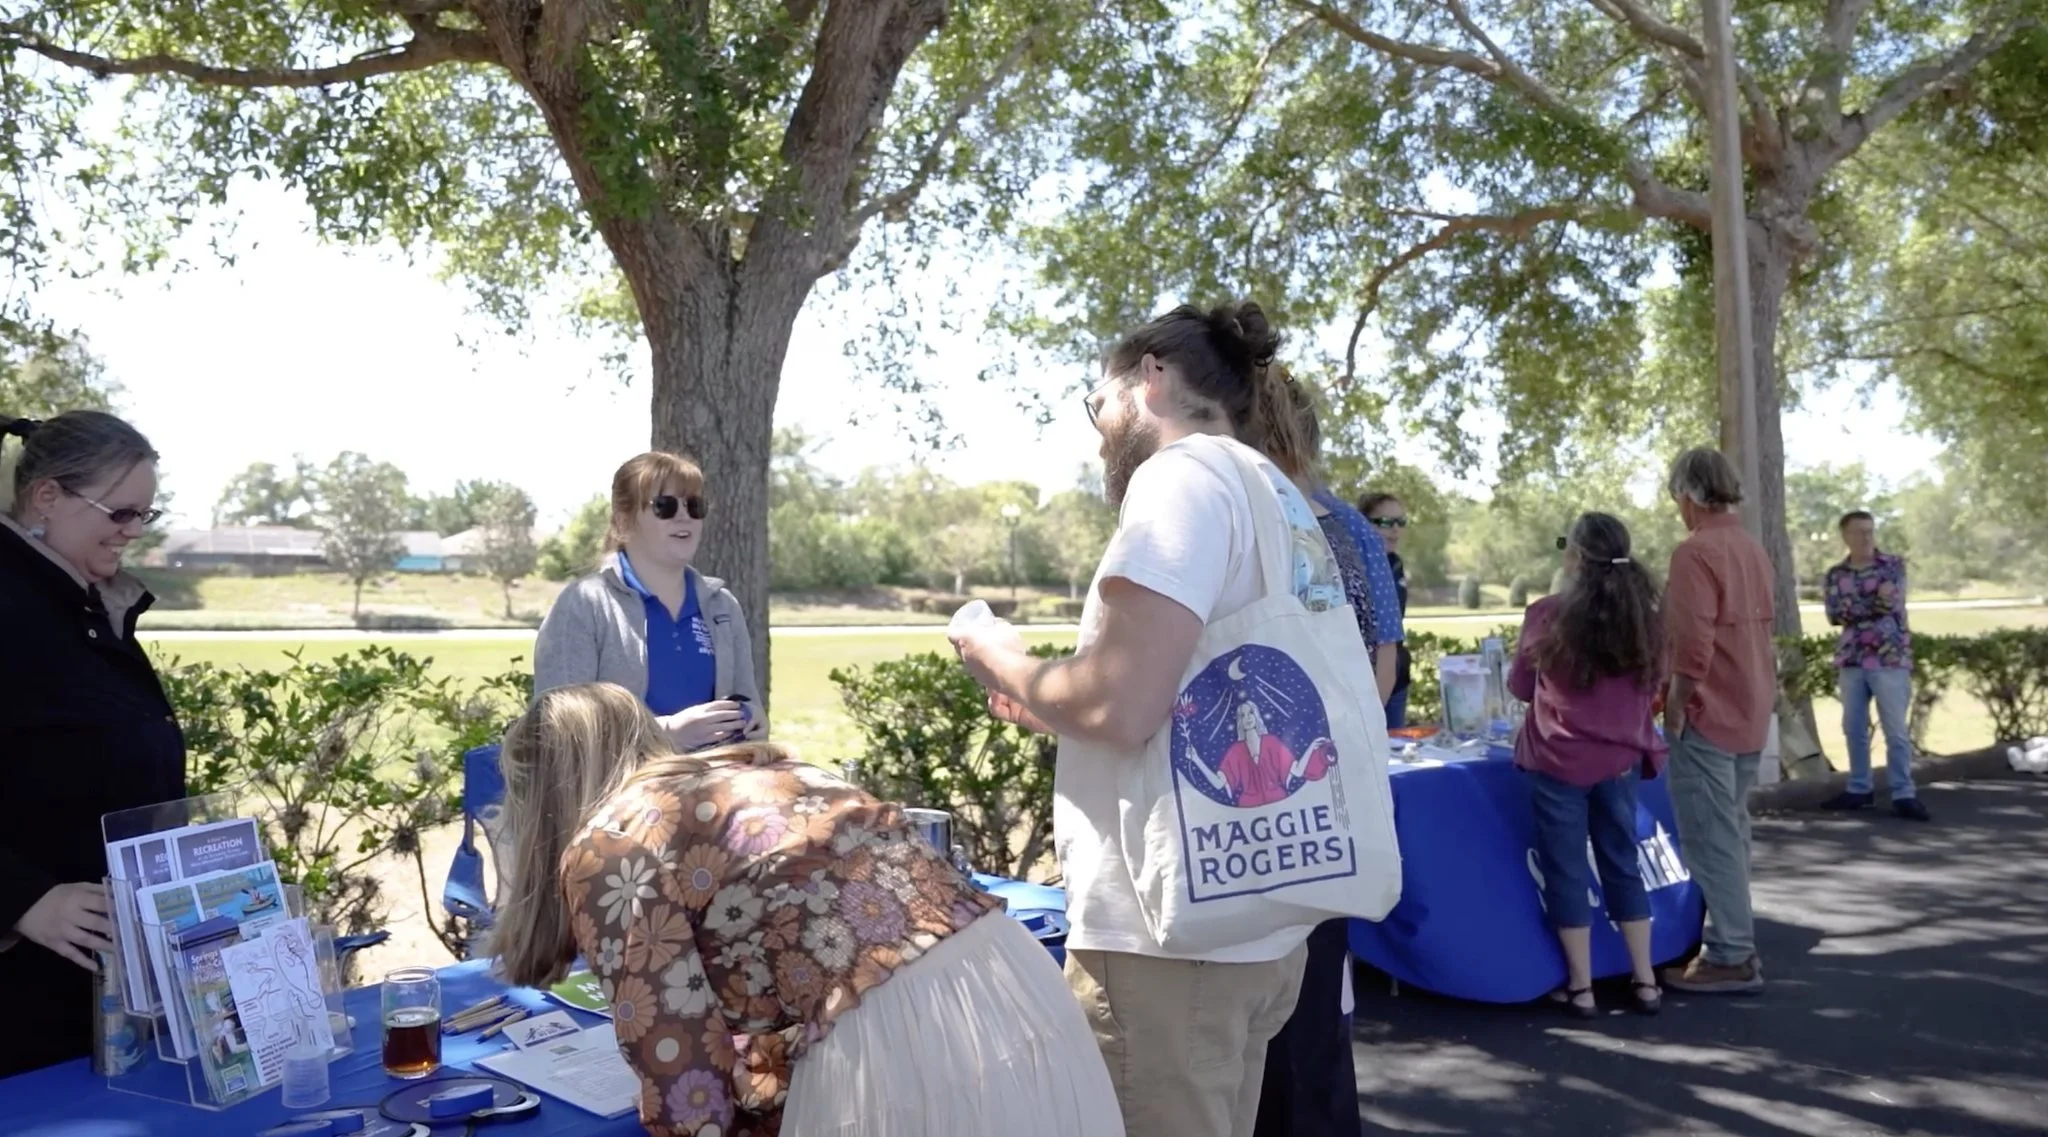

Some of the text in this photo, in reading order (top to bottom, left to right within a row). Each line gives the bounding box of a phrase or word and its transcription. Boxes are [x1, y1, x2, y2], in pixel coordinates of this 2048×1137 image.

[193, 837, 243, 857] RECREATION
[1191, 805, 1332, 852] MAGGIE
[1199, 836, 1344, 885] ROGERS
